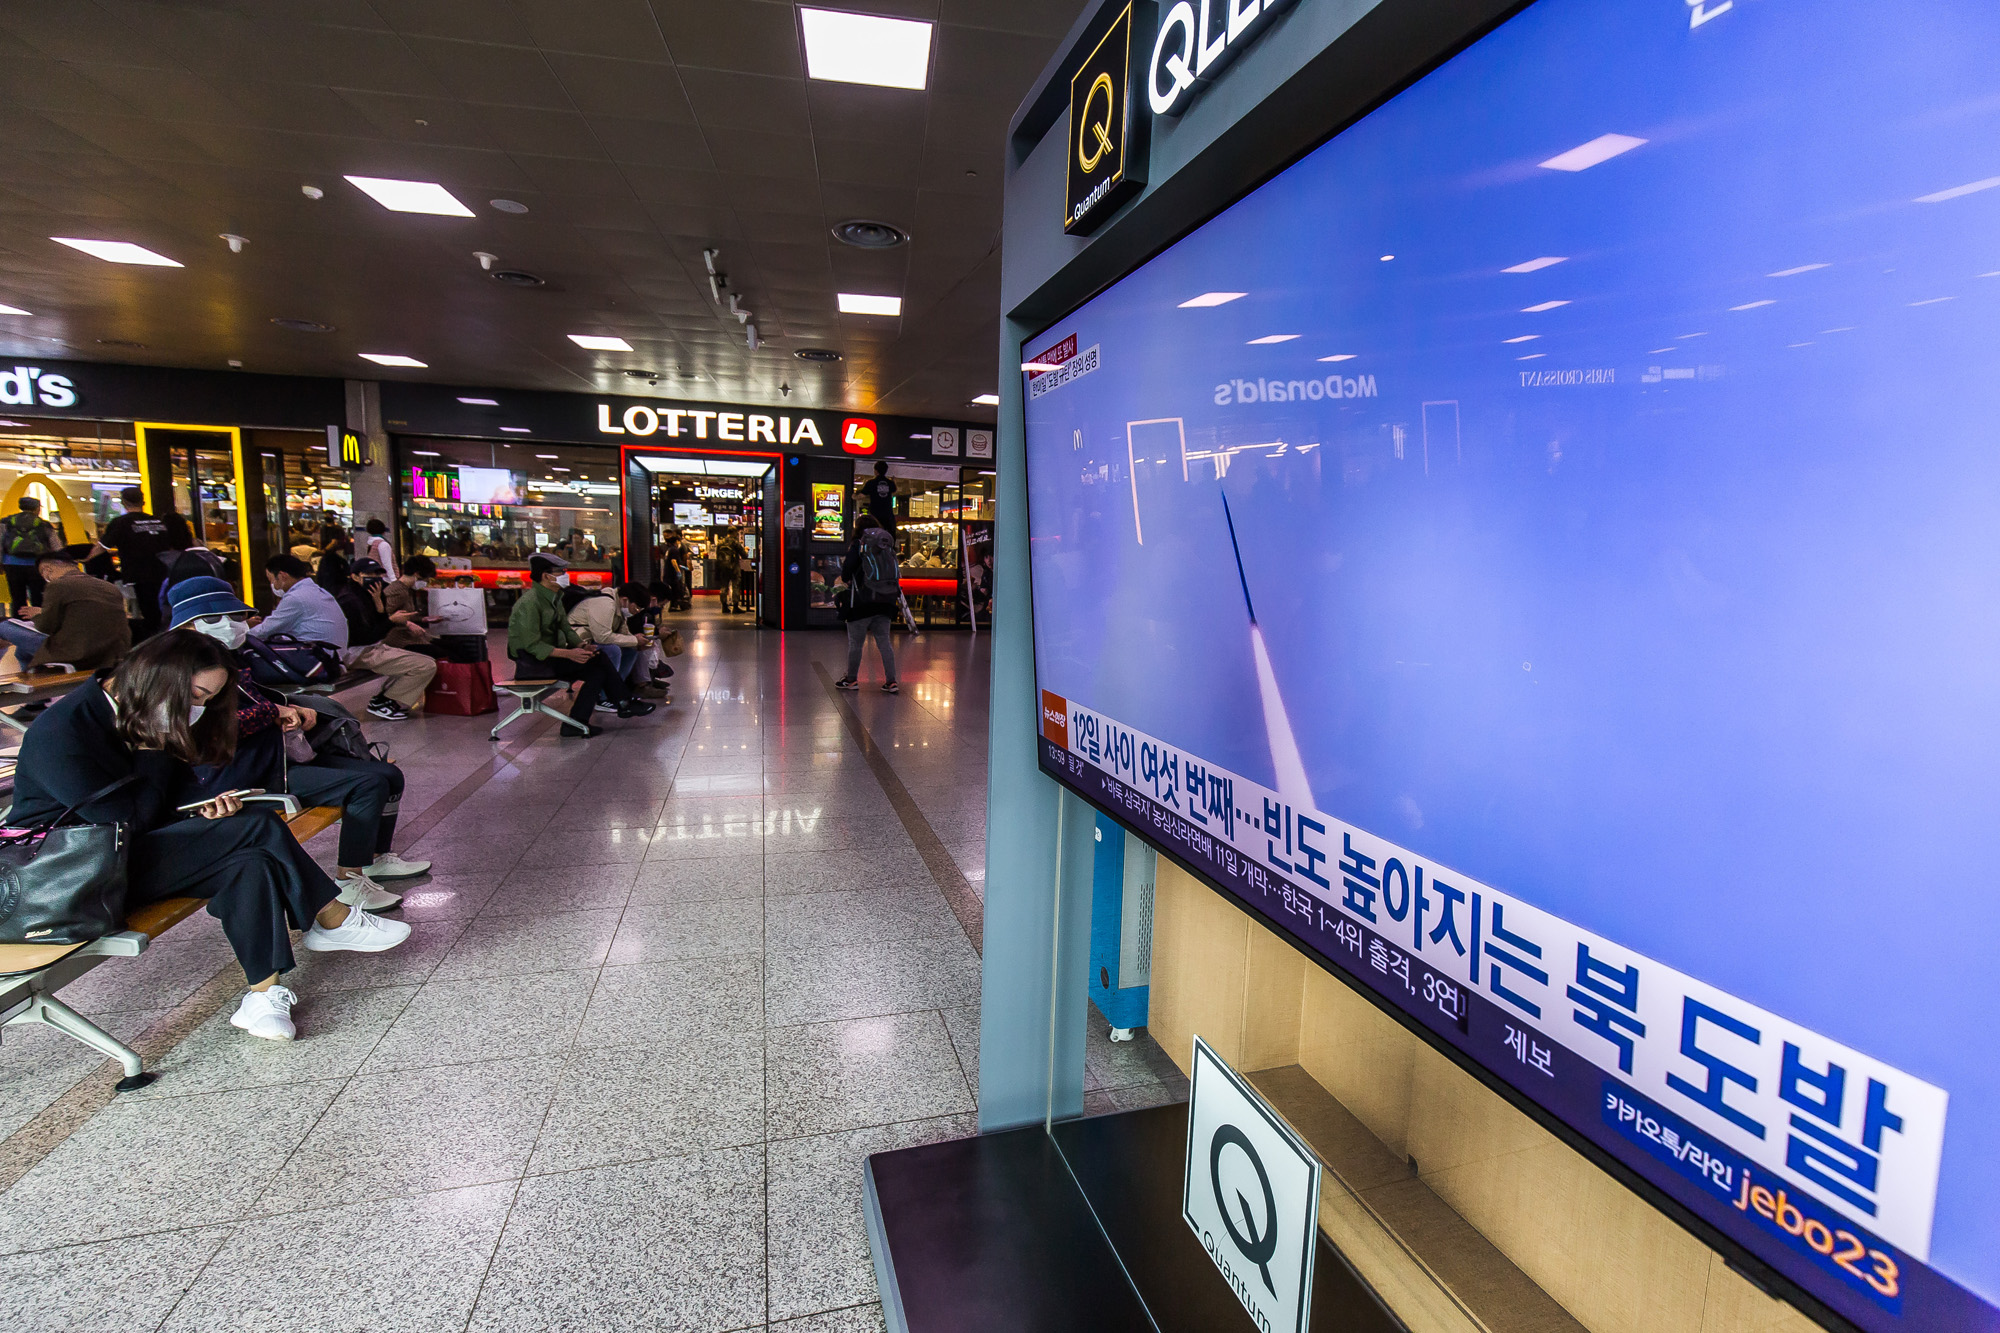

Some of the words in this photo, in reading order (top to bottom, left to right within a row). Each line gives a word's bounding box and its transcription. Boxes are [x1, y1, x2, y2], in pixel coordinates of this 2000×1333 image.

[1148, 0, 1279, 114] QL
[1073, 176, 1111, 221] Quantum
[1032, 377, 1047, 396] 한미일
[1072, 355, 1084, 378] 장외
[1084, 349, 1097, 371] 성명
[1063, 337, 1074, 359] 발사
[598, 403, 824, 446] LOTTERIA
[1044, 706, 1066, 728] 뉴스현장
[1048, 744, 1066, 765] 13:59
[1152, 804, 1213, 861] 농심신라면배
[1215, 843, 1238, 878] 11일
[1318, 906, 1363, 959] 1~4위
[1368, 937, 1416, 996] 출격,
[1073, 711, 1101, 765] 12일
[1103, 724, 1137, 786] 사이
[1141, 741, 1180, 810] 여섯
[1339, 832, 1549, 1021] 높아지는
[1567, 941, 1647, 1076] 북
[1666, 994, 1904, 1219] 도발
[1503, 1023, 1555, 1078] 제보
[1606, 1092, 1733, 1193] 카카오톡/라인
[1733, 1168, 1901, 1299] jebo23
[1203, 1230, 1272, 1333] Quantum
